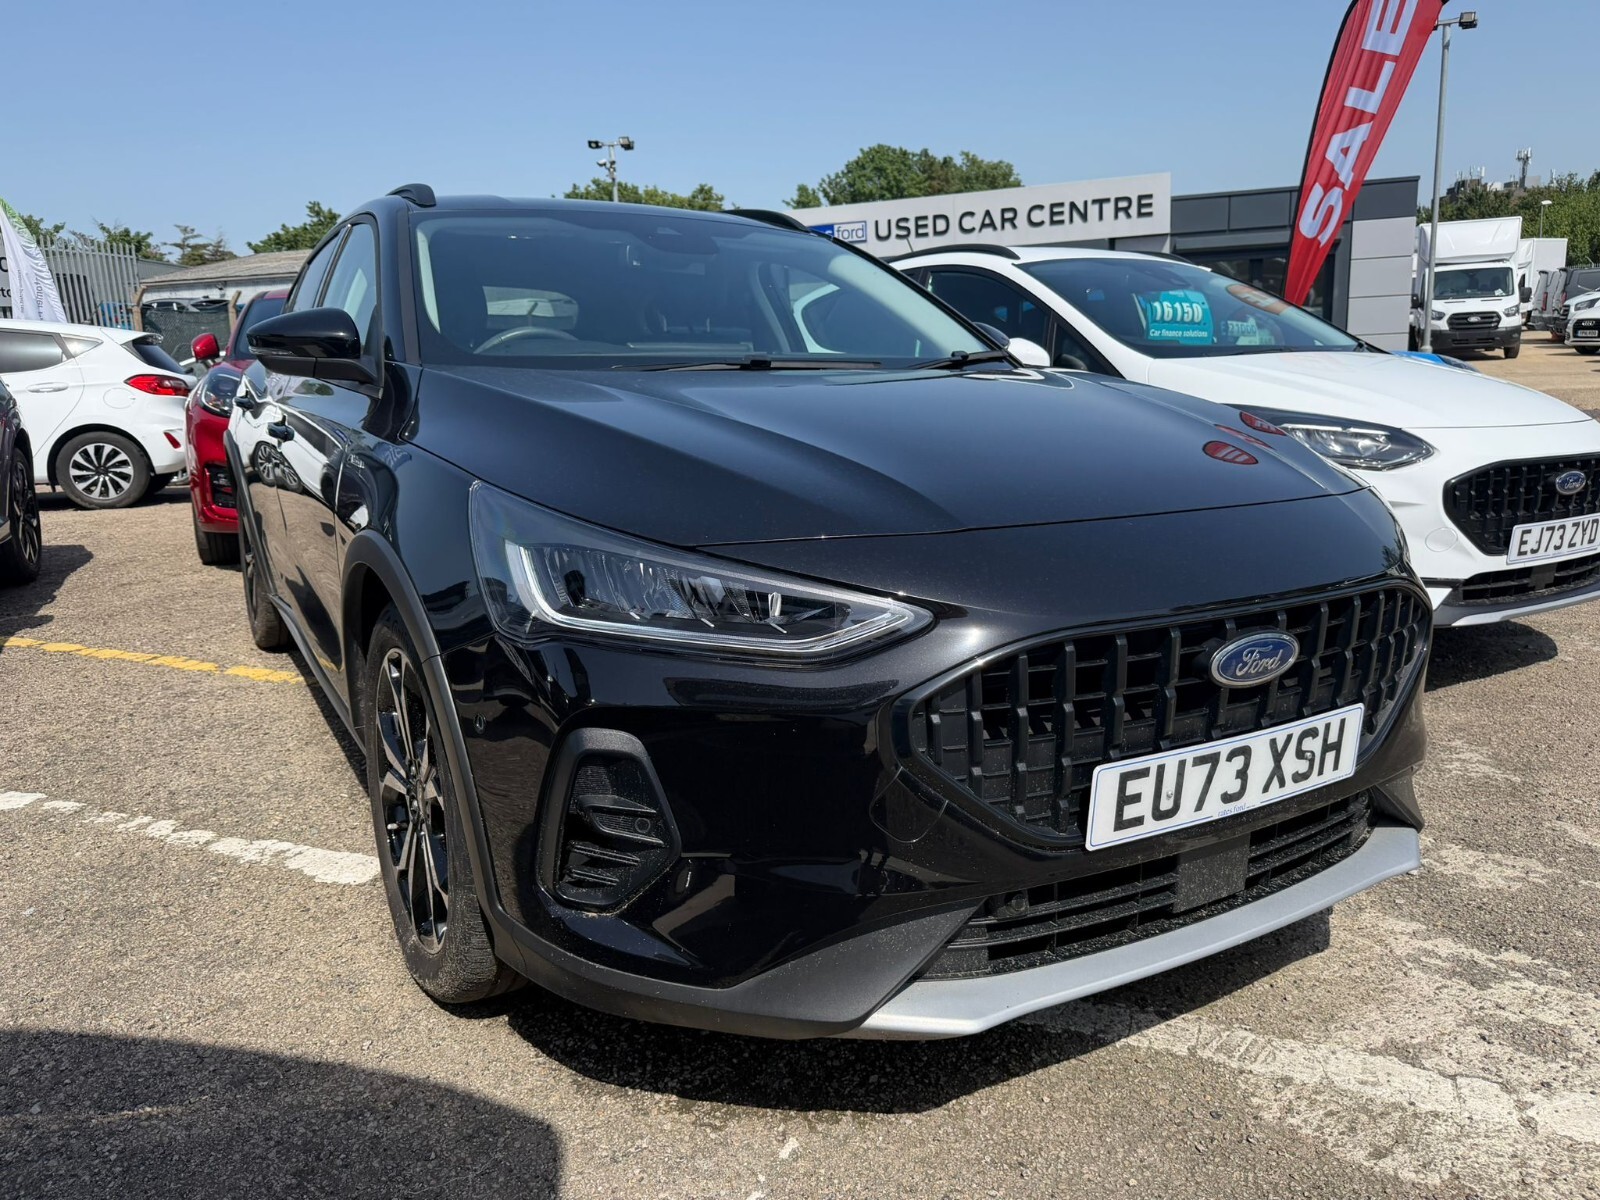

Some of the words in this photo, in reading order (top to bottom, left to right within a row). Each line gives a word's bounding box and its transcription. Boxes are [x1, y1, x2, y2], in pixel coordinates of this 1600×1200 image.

[1299, 0, 1418, 248] SALE
[836, 224, 865, 239] ford
[875, 214, 950, 242] USED
[958, 207, 1018, 234] CAR
[1026, 193, 1153, 228] CENTRE
[1151, 301, 1203, 323] 16150
[1150, 329, 1161, 337] Car
[1161, 329, 1182, 337] finance
[1183, 330, 1208, 338] solutions
[1564, 475, 1582, 489] Ford
[1517, 524, 1567, 556] EJ73
[1567, 518, 1600, 549] ZYD
[1236, 645, 1283, 676] Ford
[1113, 745, 1252, 833] EU73
[1262, 718, 1346, 794] XSH
